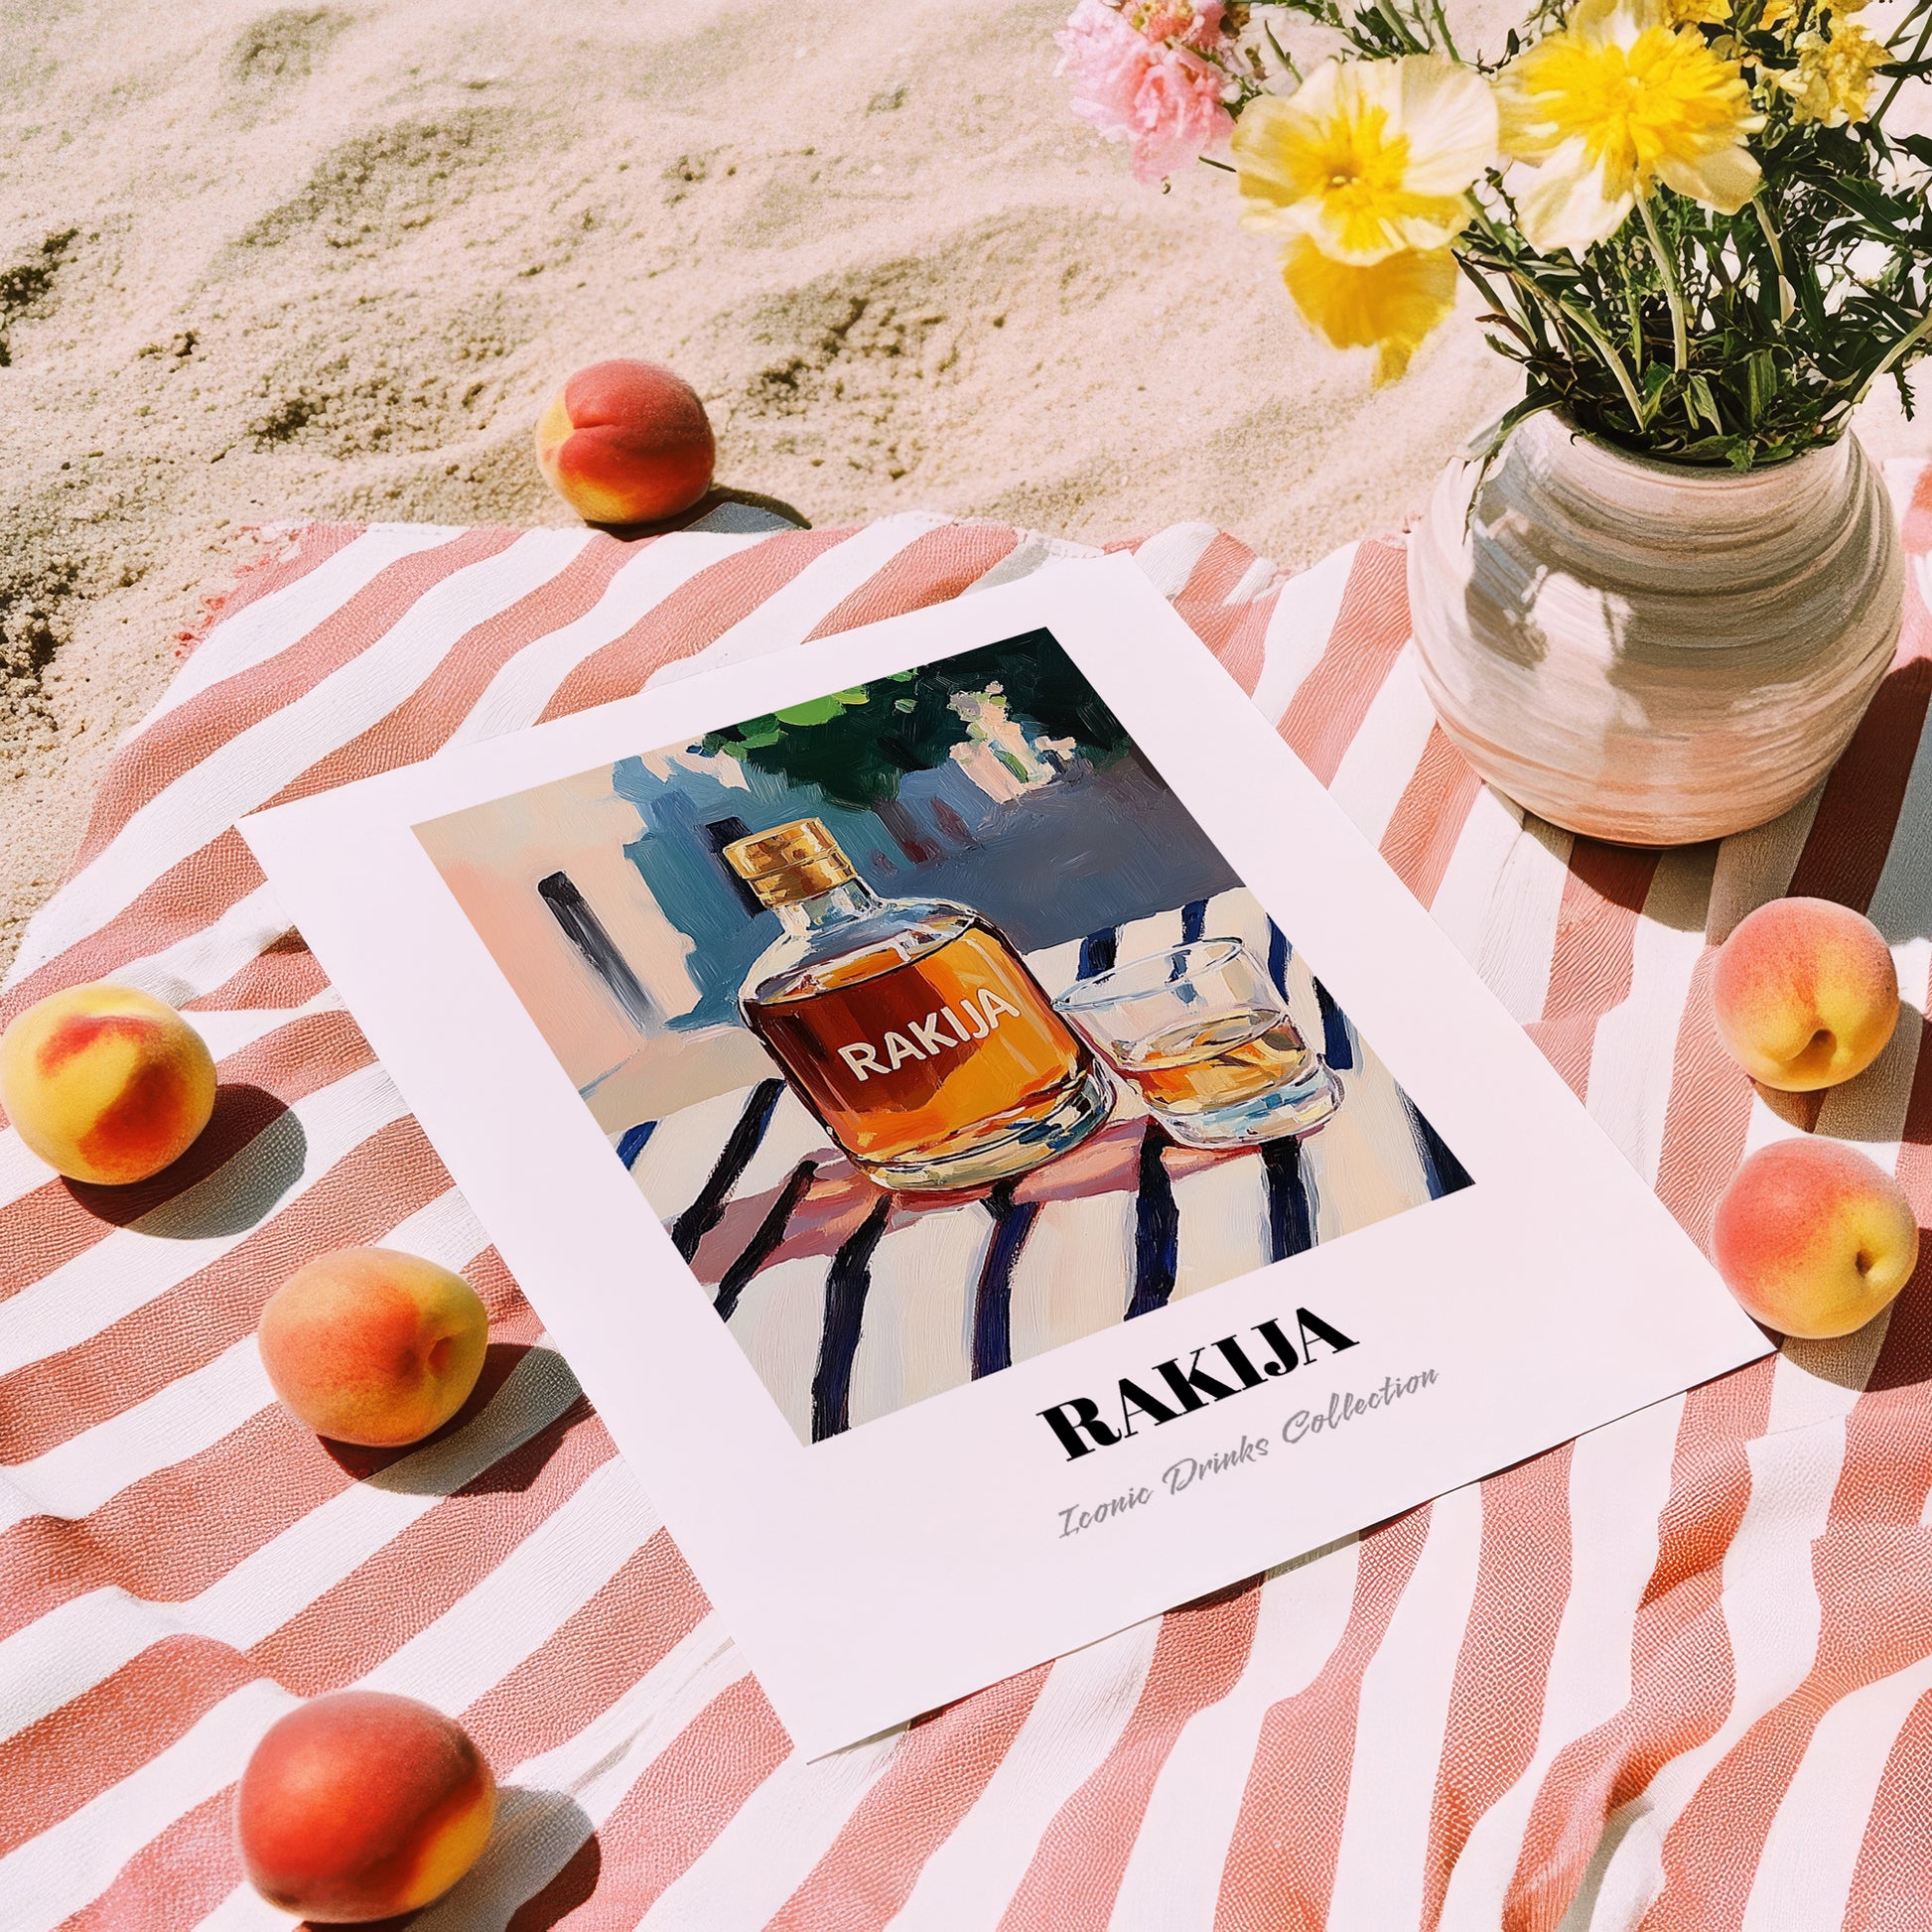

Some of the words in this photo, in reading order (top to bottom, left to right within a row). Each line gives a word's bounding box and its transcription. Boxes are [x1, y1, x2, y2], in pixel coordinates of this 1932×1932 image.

[837, 988, 1021, 1082] RAKIJA
[1035, 1307, 1360, 1462] RAKIJA
[1057, 1487, 1155, 1540] Iconic
[1161, 1435, 1270, 1496] Drinks
[1281, 1368, 1440, 1445] Collection
